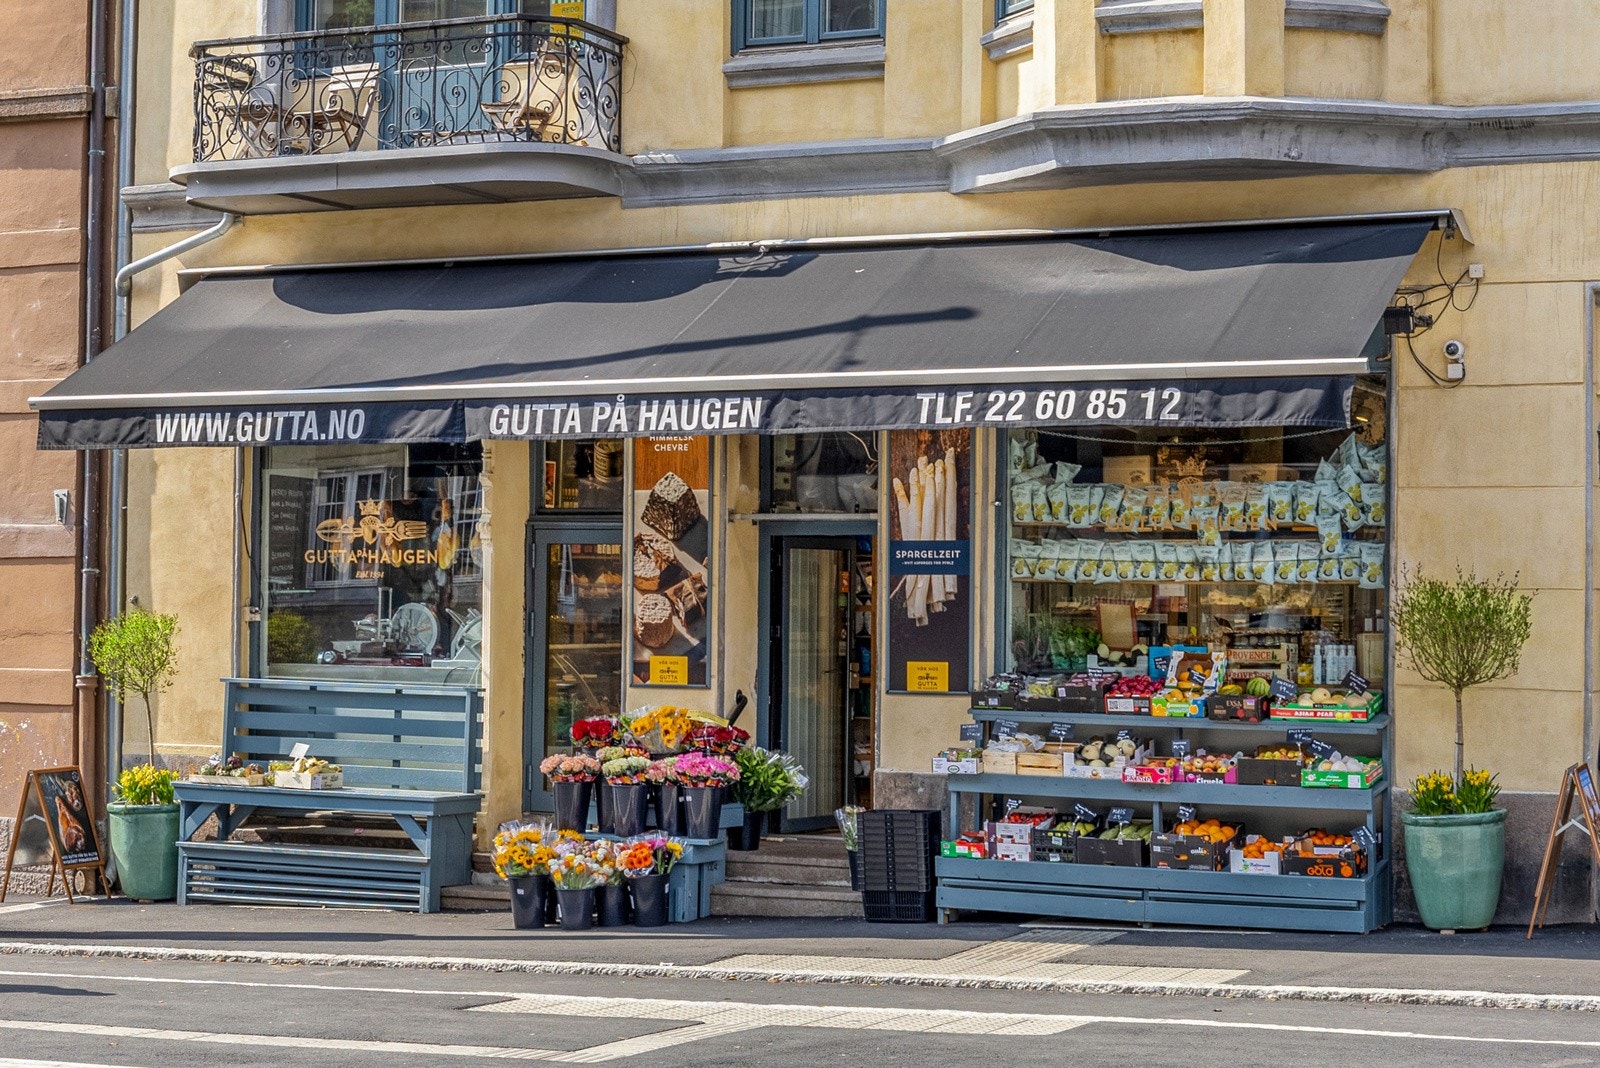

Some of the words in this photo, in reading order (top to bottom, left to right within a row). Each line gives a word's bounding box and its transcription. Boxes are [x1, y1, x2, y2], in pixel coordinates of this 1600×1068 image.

[489, 403, 582, 435] GUTTA
[590, 393, 629, 433] PÅ
[637, 397, 763, 432] HAUGEN
[916, 391, 974, 424] TLF.
[984, 389, 1026, 422] 22
[1035, 389, 1077, 420] 60
[1086, 388, 1128, 419] 85
[1140, 387, 1182, 421] 12
[155, 408, 366, 443] WWW.GUTTA.NO
[654, 443, 689, 452] CHEVRE
[1105, 515, 1175, 531] GUTTA
[1188, 515, 1278, 532] HAUGEN
[304, 549, 358, 564] GUTTA
[357, 547, 368, 558] PÅ
[368, 549, 438, 564] HAUGEN
[895, 550, 961, 559] SPARGELZEIT
[1226, 649, 1271, 660] PROVENCE
